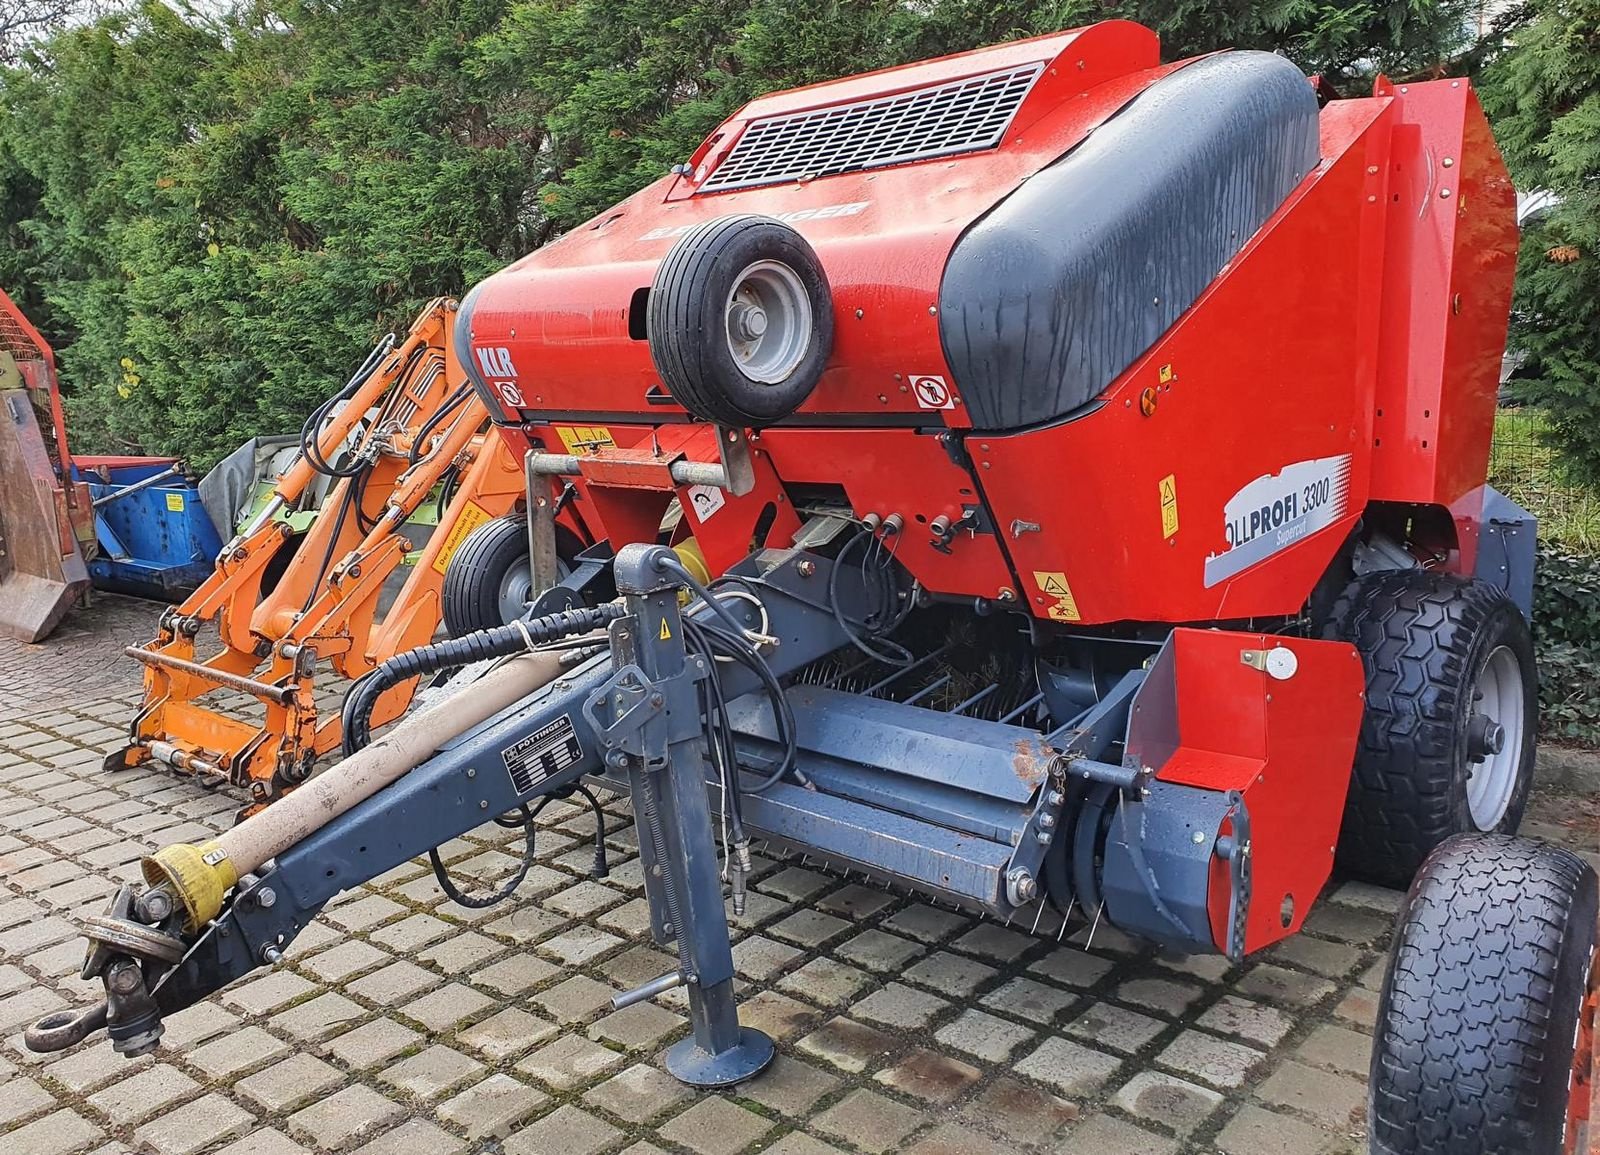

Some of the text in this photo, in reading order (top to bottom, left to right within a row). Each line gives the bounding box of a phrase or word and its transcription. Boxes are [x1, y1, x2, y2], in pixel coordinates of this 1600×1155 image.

[475, 347, 518, 377] KLR
[1225, 477, 1329, 547] OLLPROFI 3300
[439, 553, 449, 566] Der
[447, 518, 467, 552] Aufenthalt
